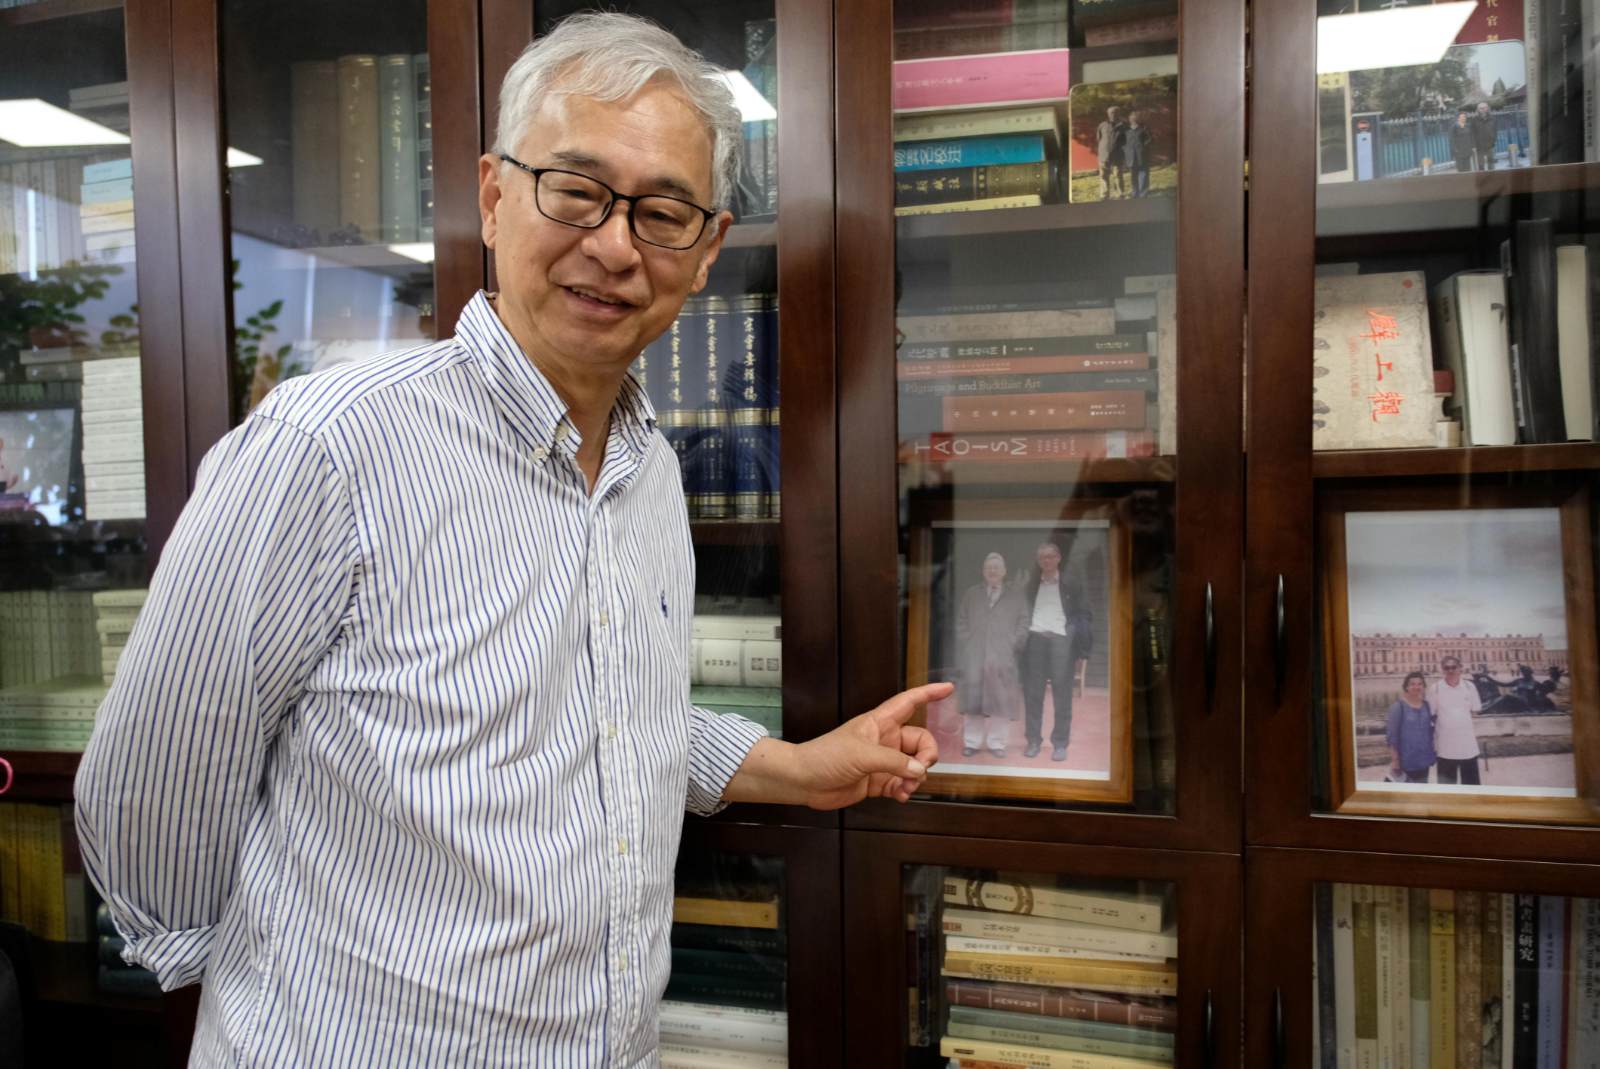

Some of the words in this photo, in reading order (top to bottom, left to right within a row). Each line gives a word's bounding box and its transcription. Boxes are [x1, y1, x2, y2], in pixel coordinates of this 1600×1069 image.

[958, 380, 978, 392] and
[1025, 377, 1041, 390] Art
[914, 436, 1028, 456] TAOISM
